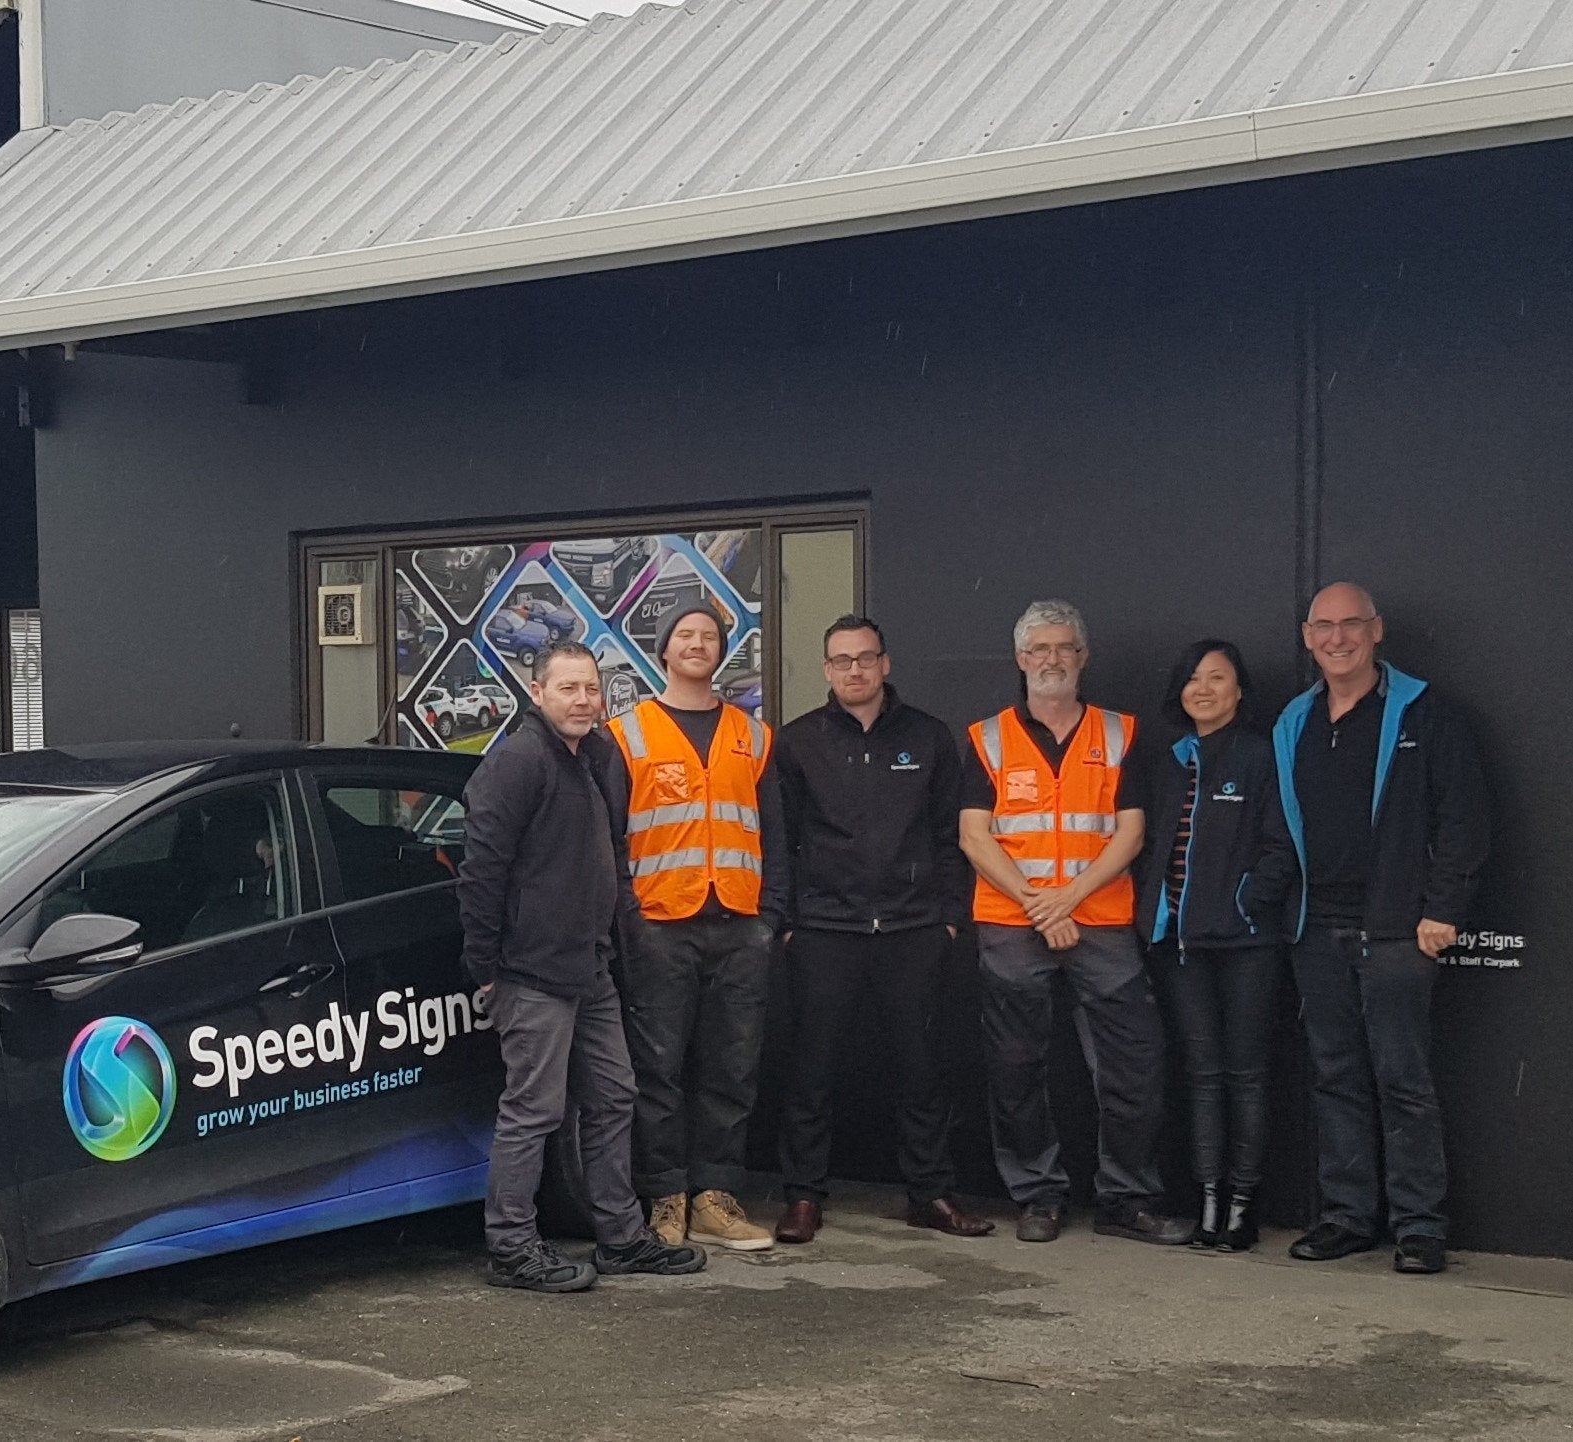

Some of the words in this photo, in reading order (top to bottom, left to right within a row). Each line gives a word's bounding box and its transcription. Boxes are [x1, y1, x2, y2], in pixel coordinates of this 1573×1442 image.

[1459, 956, 1480, 966] Staff
[1483, 956, 1520, 968] Carpark
[1478, 930, 1524, 951] Signs
[188, 1001, 370, 1097] Speedy
[376, 986, 495, 1056] Signs
[196, 1103, 244, 1137] grow
[248, 1095, 290, 1126] your
[293, 1080, 370, 1112] business
[373, 1064, 423, 1094] faster
